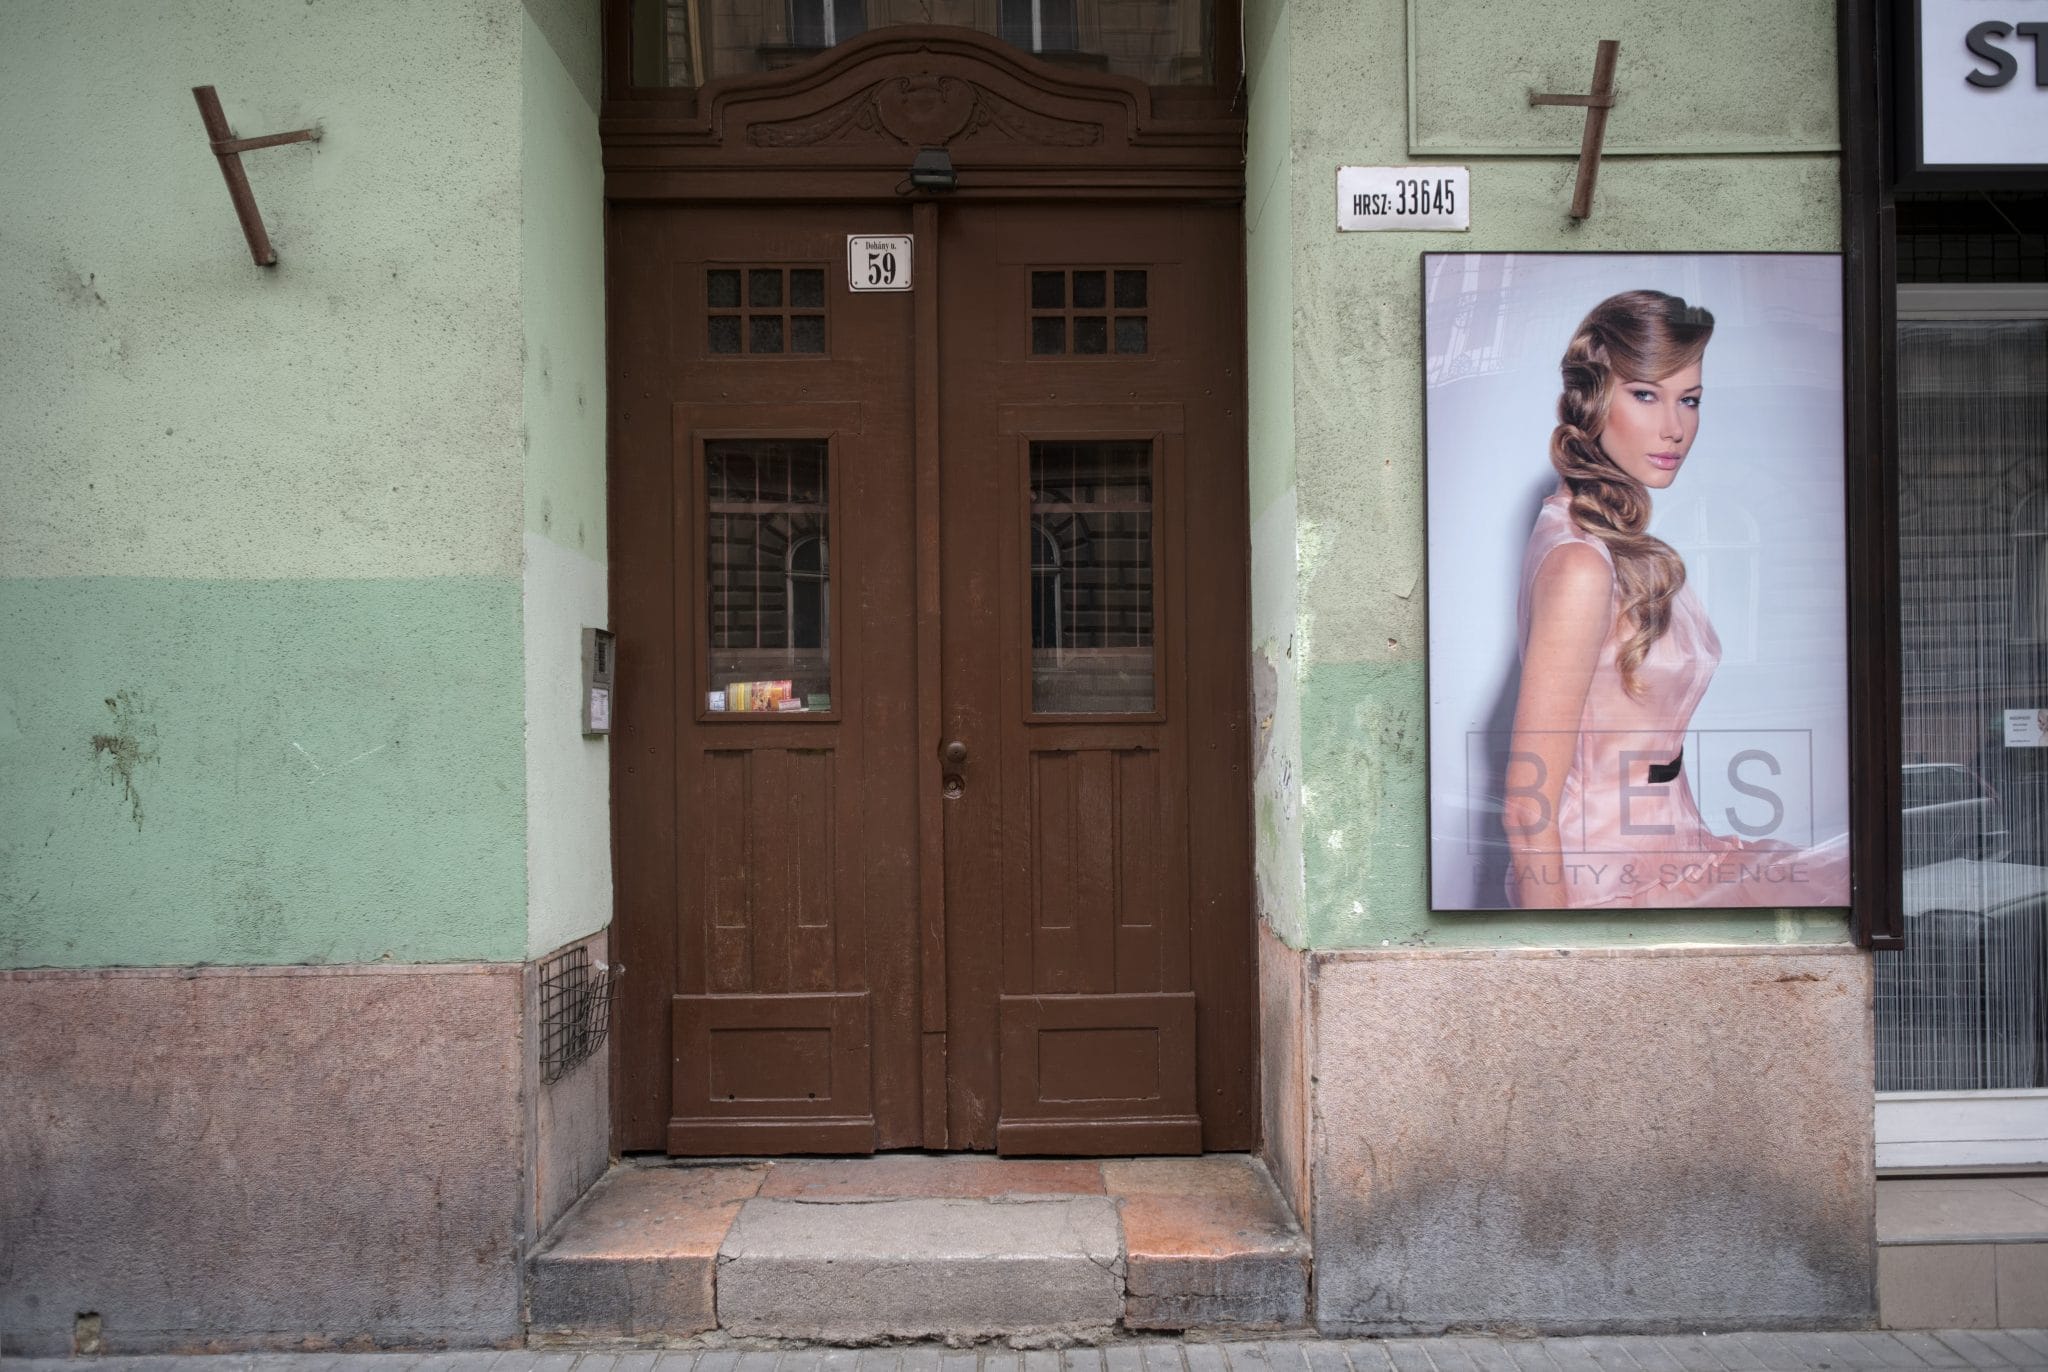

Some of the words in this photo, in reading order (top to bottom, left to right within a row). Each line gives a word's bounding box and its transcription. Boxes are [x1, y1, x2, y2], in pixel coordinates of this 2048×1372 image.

[1353, 194, 1392, 216] HRSZ:
[1396, 179, 1455, 216] 33645
[865, 241, 889, 252] Dohány
[868, 252, 896, 285] 59
[1493, 749, 1785, 837] BES
[1619, 863, 1641, 885] &
[1659, 862, 1811, 885] SCIENCE
